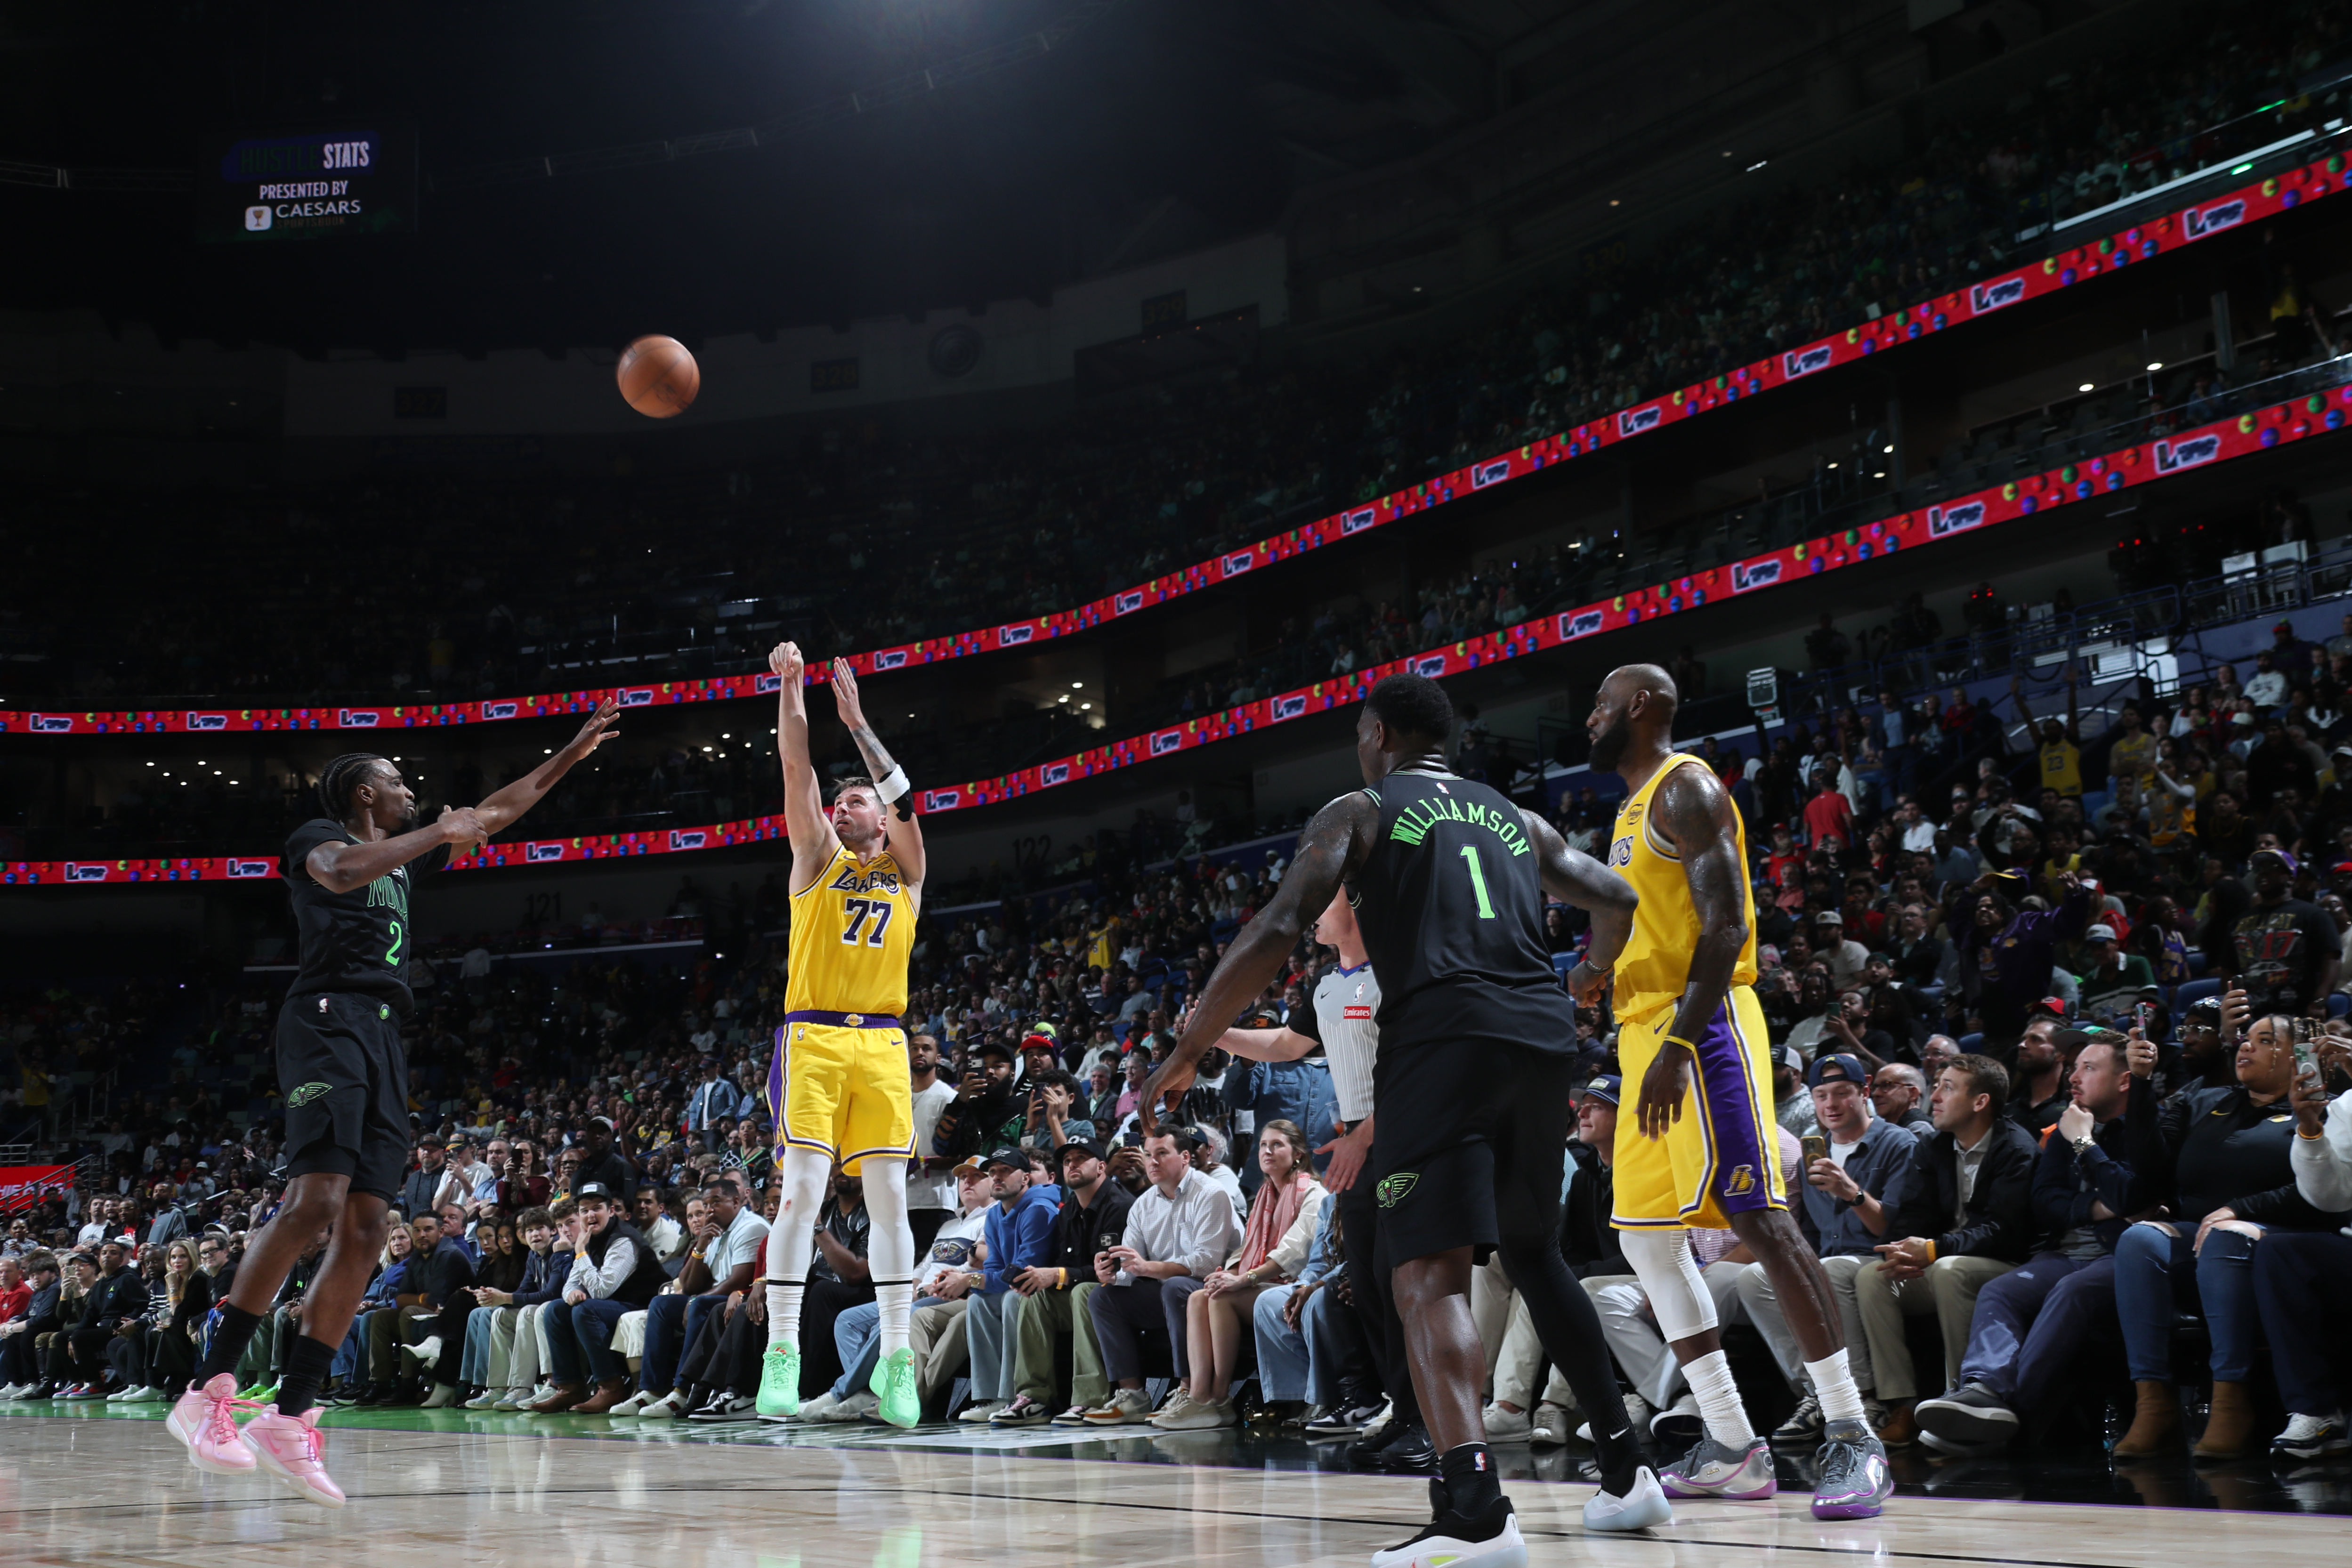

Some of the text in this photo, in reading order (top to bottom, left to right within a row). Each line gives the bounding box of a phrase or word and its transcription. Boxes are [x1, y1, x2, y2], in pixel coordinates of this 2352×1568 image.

[240, 141, 370, 173] HUSTLE STATS
[259, 180, 348, 200] PRESENTED BY
[275, 199, 361, 218] CAESARS
[1390, 798, 1530, 857] WILLIAMSON
[827, 865, 901, 895] LAKERS
[1458, 843, 1498, 921] 1
[841, 897, 893, 948] 77
[385, 921, 403, 967] 2
[2261, 929, 2303, 959] 17
[1344, 1009, 1370, 1017] Emirates
